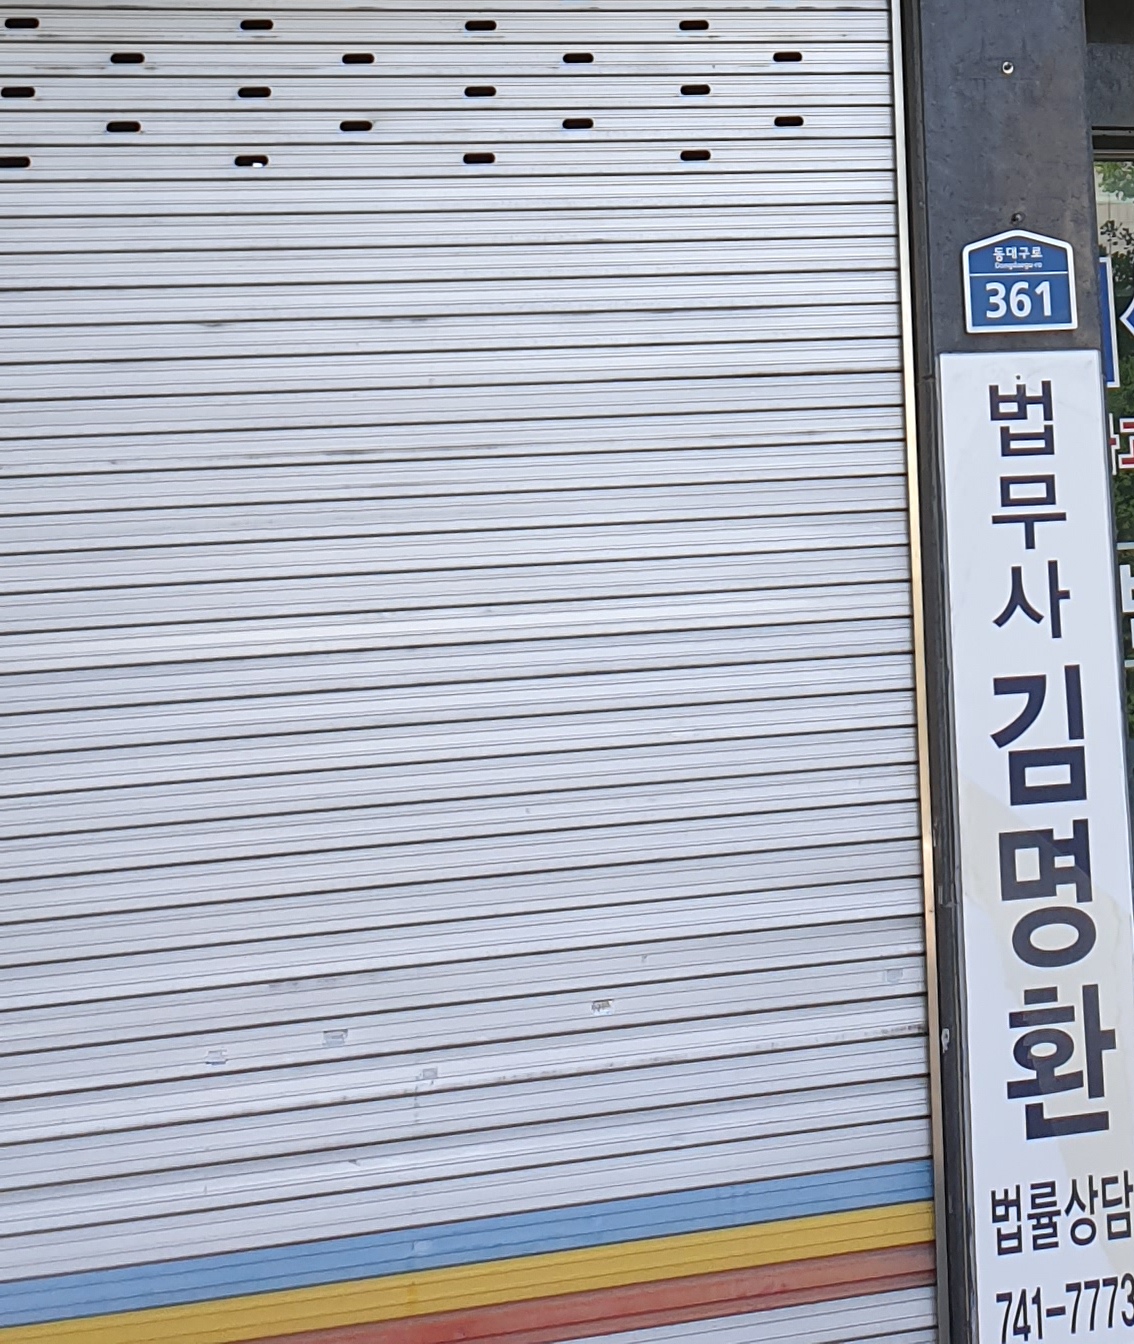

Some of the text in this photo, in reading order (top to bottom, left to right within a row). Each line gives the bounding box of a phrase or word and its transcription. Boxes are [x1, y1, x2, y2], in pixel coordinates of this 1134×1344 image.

[993, 246, 1043, 263] 동대구로
[985, 280, 1053, 320] 361
[990, 1169, 1134, 1257] 법률상담
